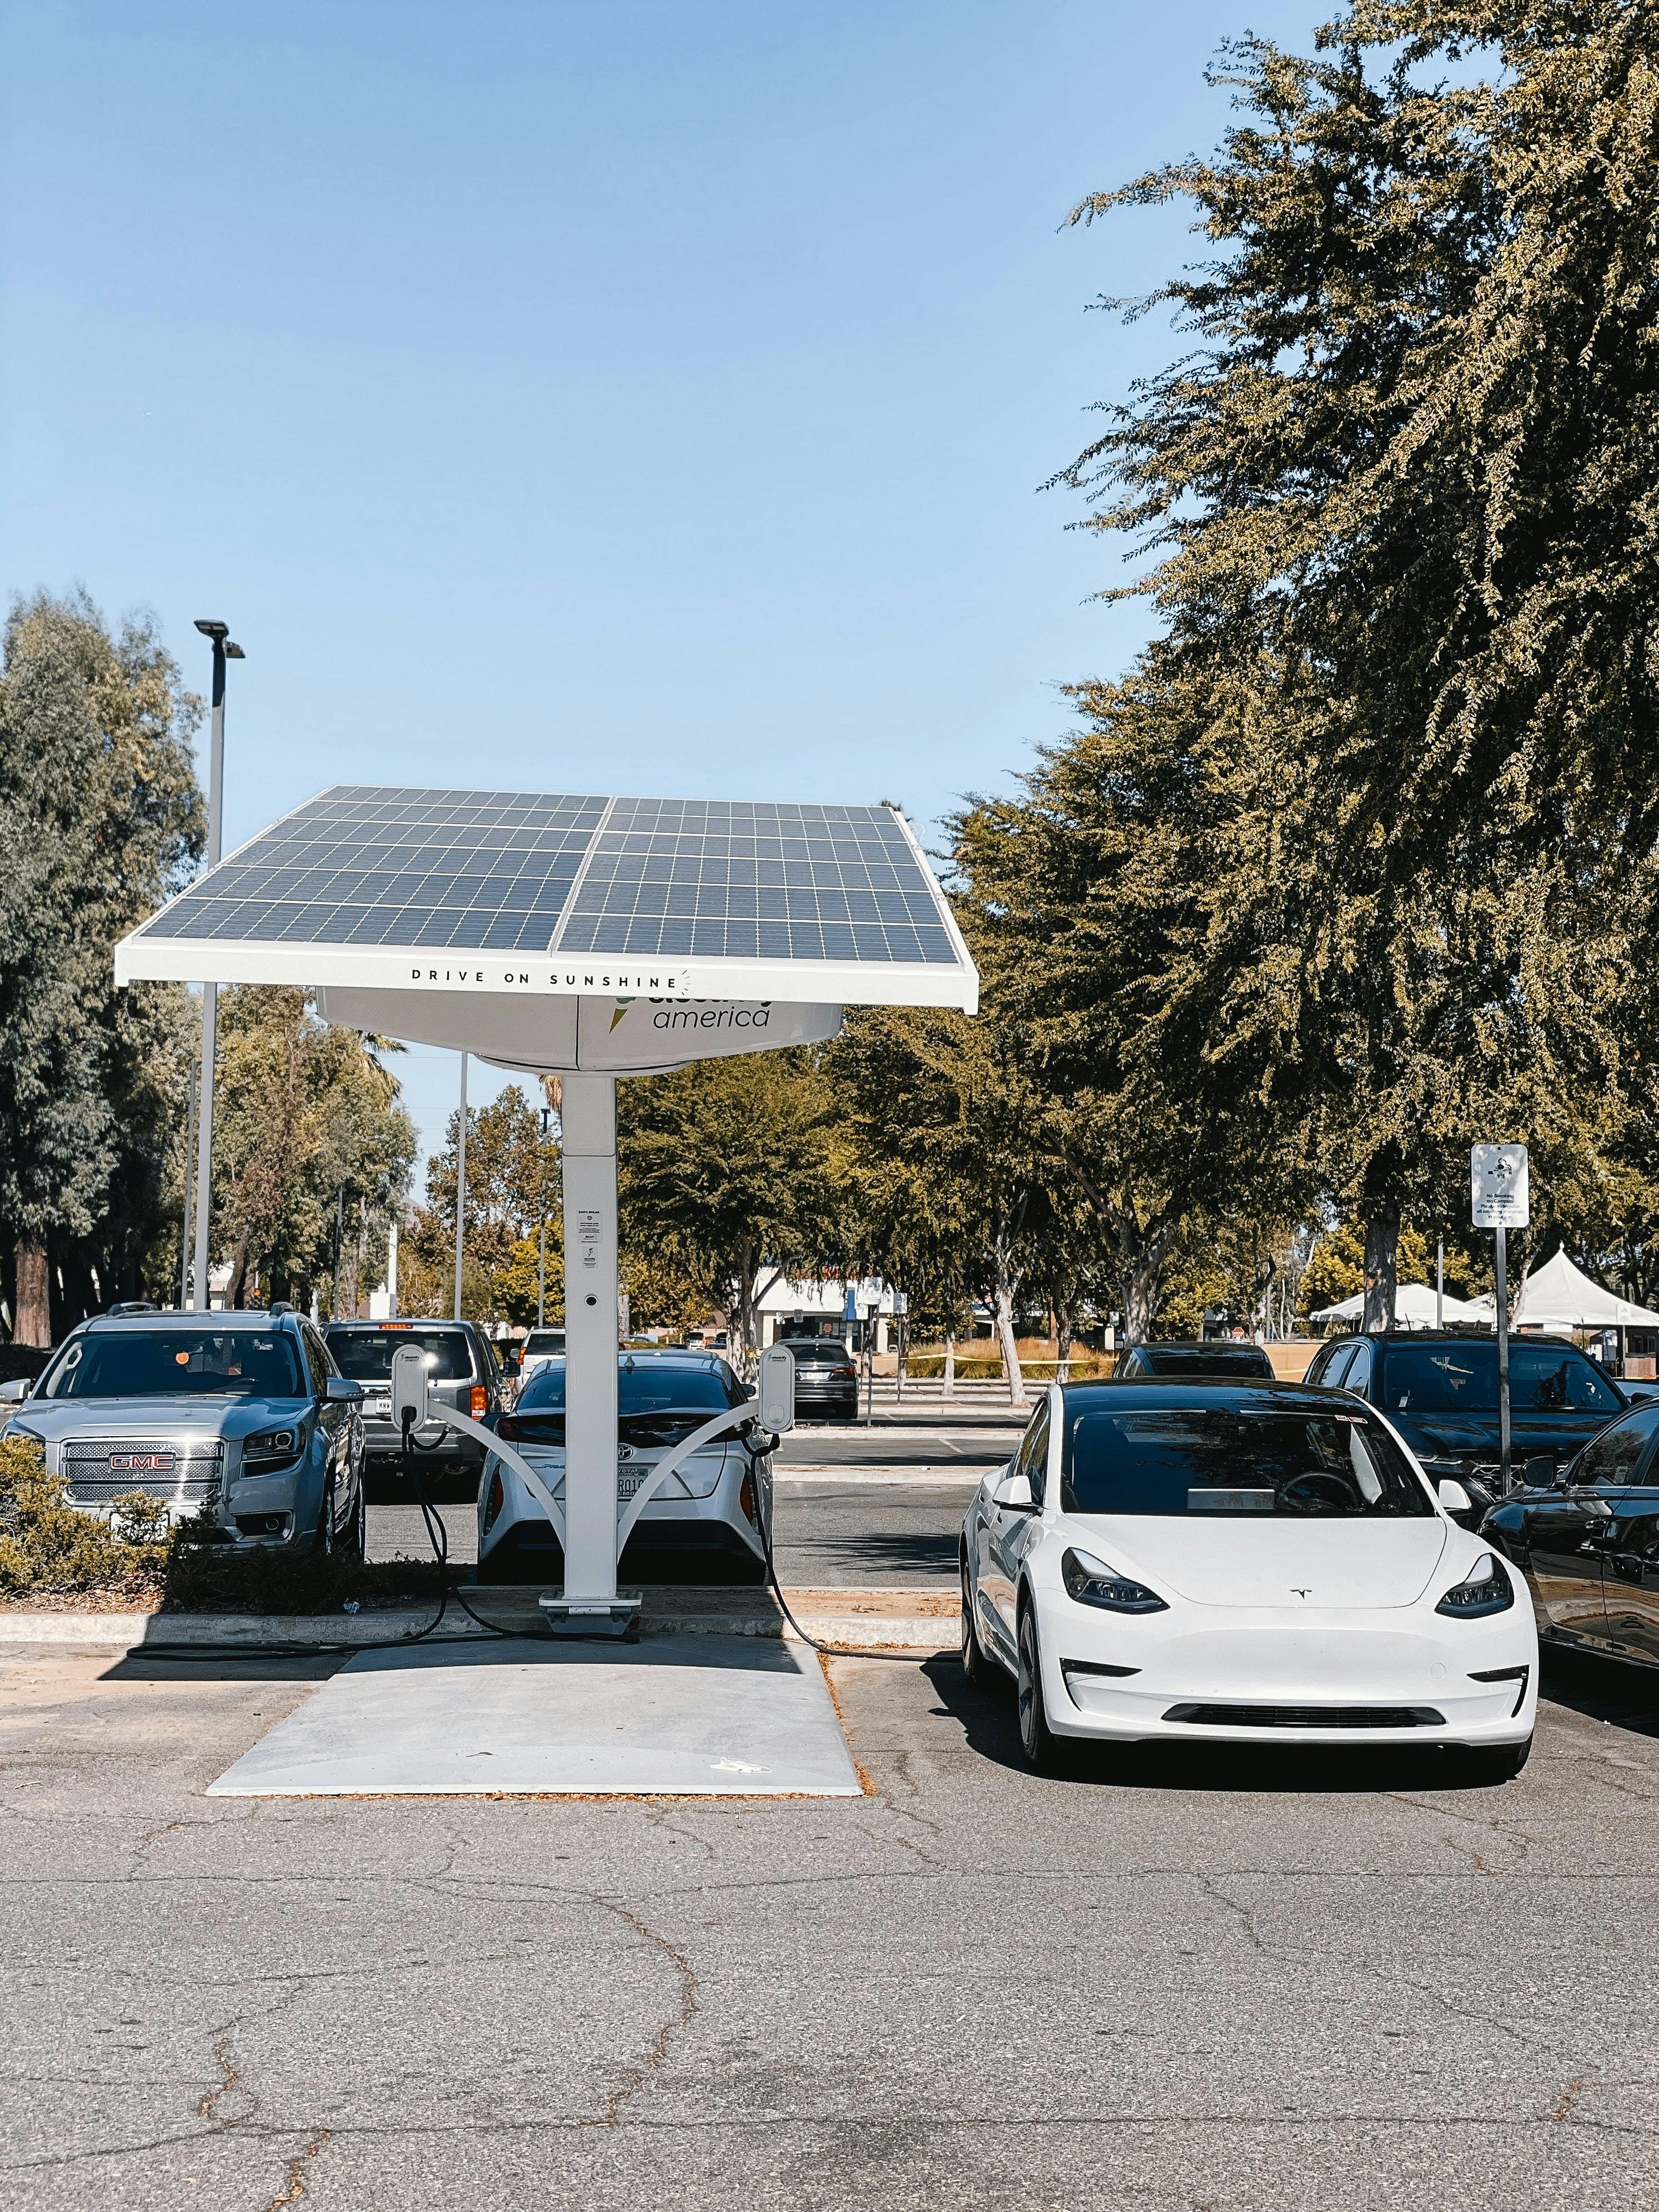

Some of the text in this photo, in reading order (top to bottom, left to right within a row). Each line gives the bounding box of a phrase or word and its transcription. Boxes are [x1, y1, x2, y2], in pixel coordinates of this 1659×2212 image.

[412, 969, 675, 988] DRIVE ON SUNSHINE
[653, 1006, 770, 1029] america
[110, 1454, 174, 1469] GMC
